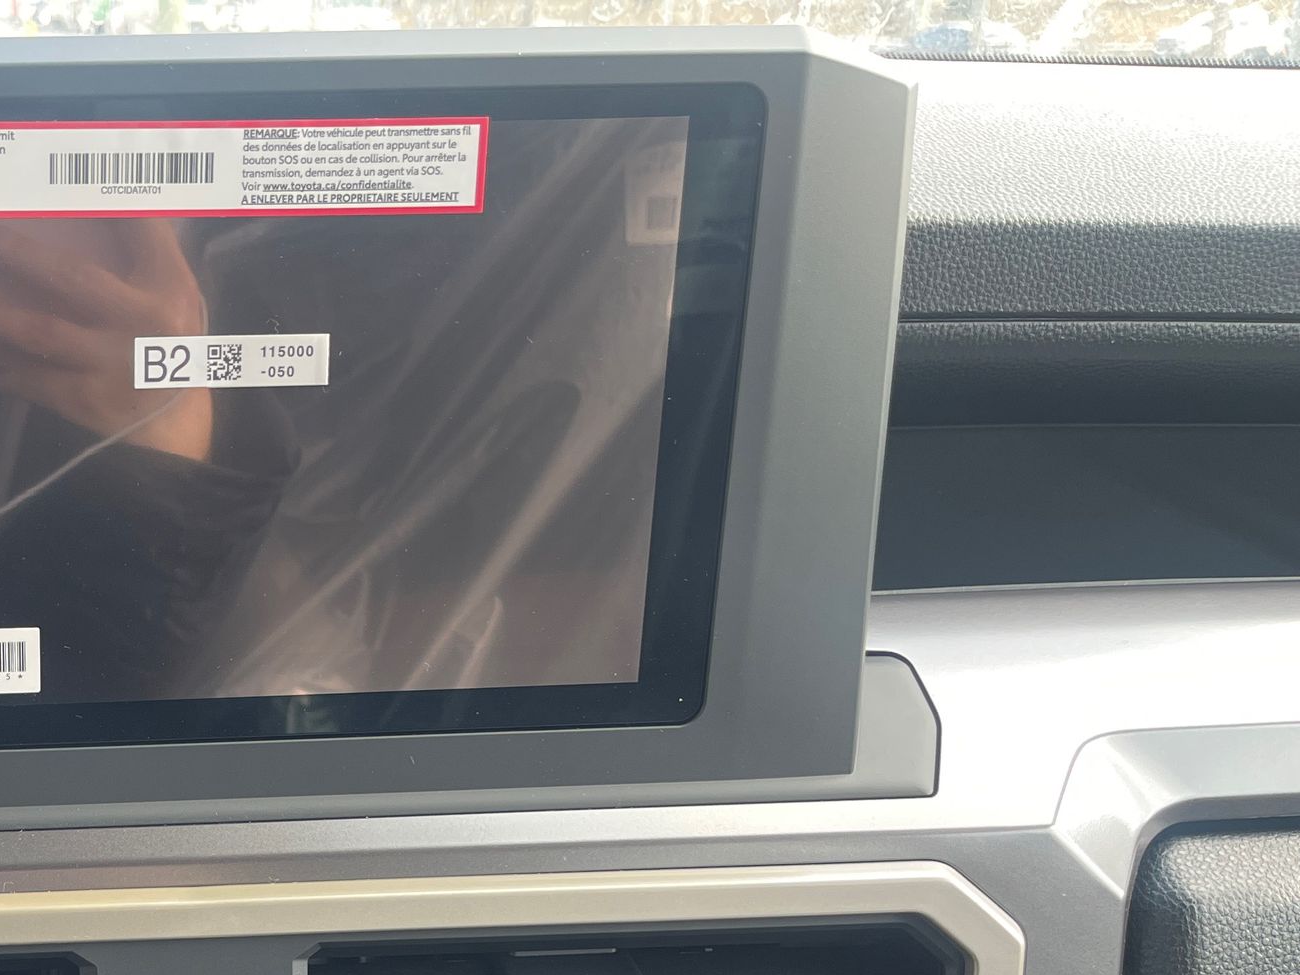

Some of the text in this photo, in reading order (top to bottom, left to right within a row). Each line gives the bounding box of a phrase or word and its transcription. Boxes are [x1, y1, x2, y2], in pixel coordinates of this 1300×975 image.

[243, 126, 471, 140] REMARQUE: Votre véhicule peut transmettre sans fil
[243, 142, 260, 152] des
[262, 142, 302, 152] données
[304, 142, 316, 151] de
[318, 141, 370, 151] localisation
[386, 142, 430, 152] appuyant
[448, 140, 457, 149] le
[243, 155, 276, 164] bouton
[278, 155, 298, 164] SOS
[314, 156, 326, 164] en
[328, 156, 344, 164] cas
[345, 154, 358, 164] de
[359, 154, 400, 163] collision.
[402, 154, 424, 162] Pour
[425, 153, 456, 162] arrêter
[458, 152, 466, 162] la
[242, 168, 303, 178] transmission,
[305, 168, 354, 177] demandez
[356, 168, 361, 176] à
[378, 168, 404, 178] agent
[406, 167, 419, 176] via
[420, 166, 443, 176] SOS.
[242, 180, 414, 192] Voir www.toyota.ca/confidentialite.
[241, 192, 459, 205] A ENLEVER PAR LE PROPRIETAIRE SEULEMENT
[143, 344, 315, 383] B2 115000
[260, 366, 295, 378] -050
